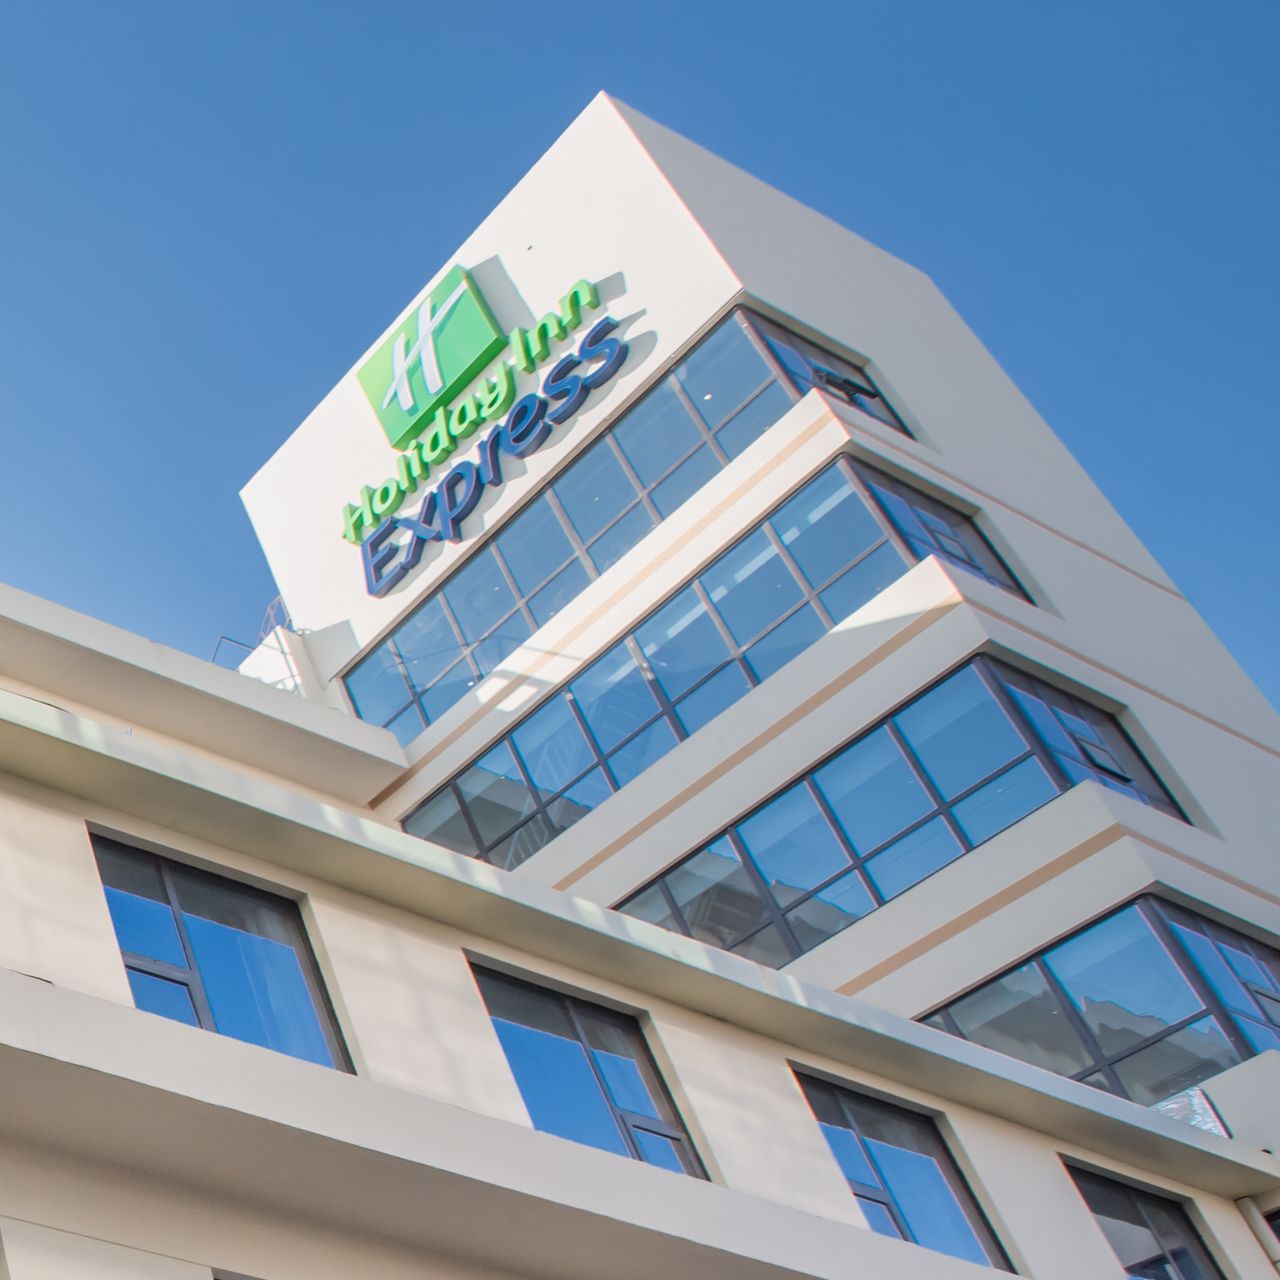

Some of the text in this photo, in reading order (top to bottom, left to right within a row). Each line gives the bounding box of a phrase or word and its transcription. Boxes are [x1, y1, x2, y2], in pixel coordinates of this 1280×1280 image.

[342, 278, 601, 546] Holiday Inn
[359, 315, 630, 600] Express
